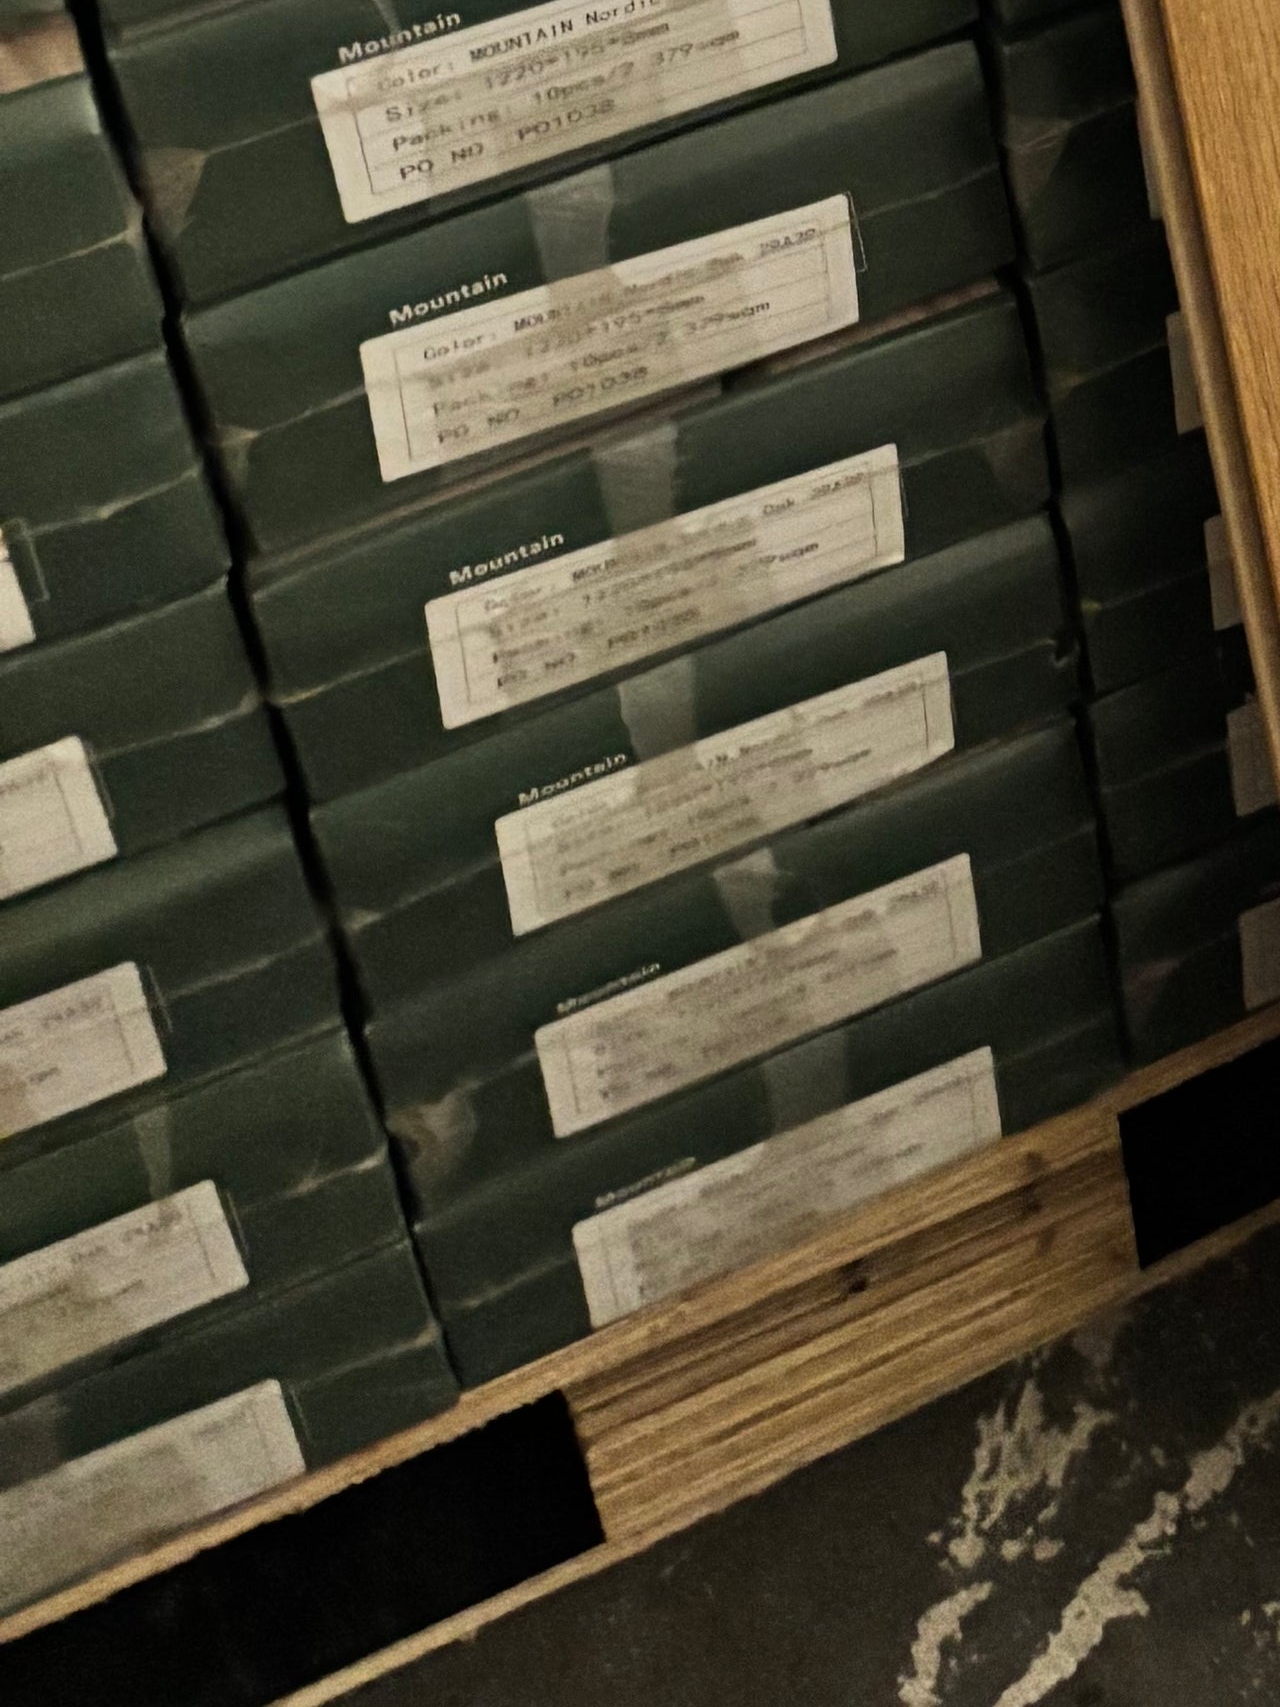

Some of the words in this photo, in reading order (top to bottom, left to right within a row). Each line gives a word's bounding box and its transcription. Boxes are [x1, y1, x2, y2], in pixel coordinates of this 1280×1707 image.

[337, 11, 461, 64] Mountain
[468, 18, 574, 64] MOUNTAIN
[400, 158, 434, 181] PO
[388, 271, 509, 327] Mountain
[449, 530, 565, 586] Mountain
[518, 751, 630, 807] Mountain
